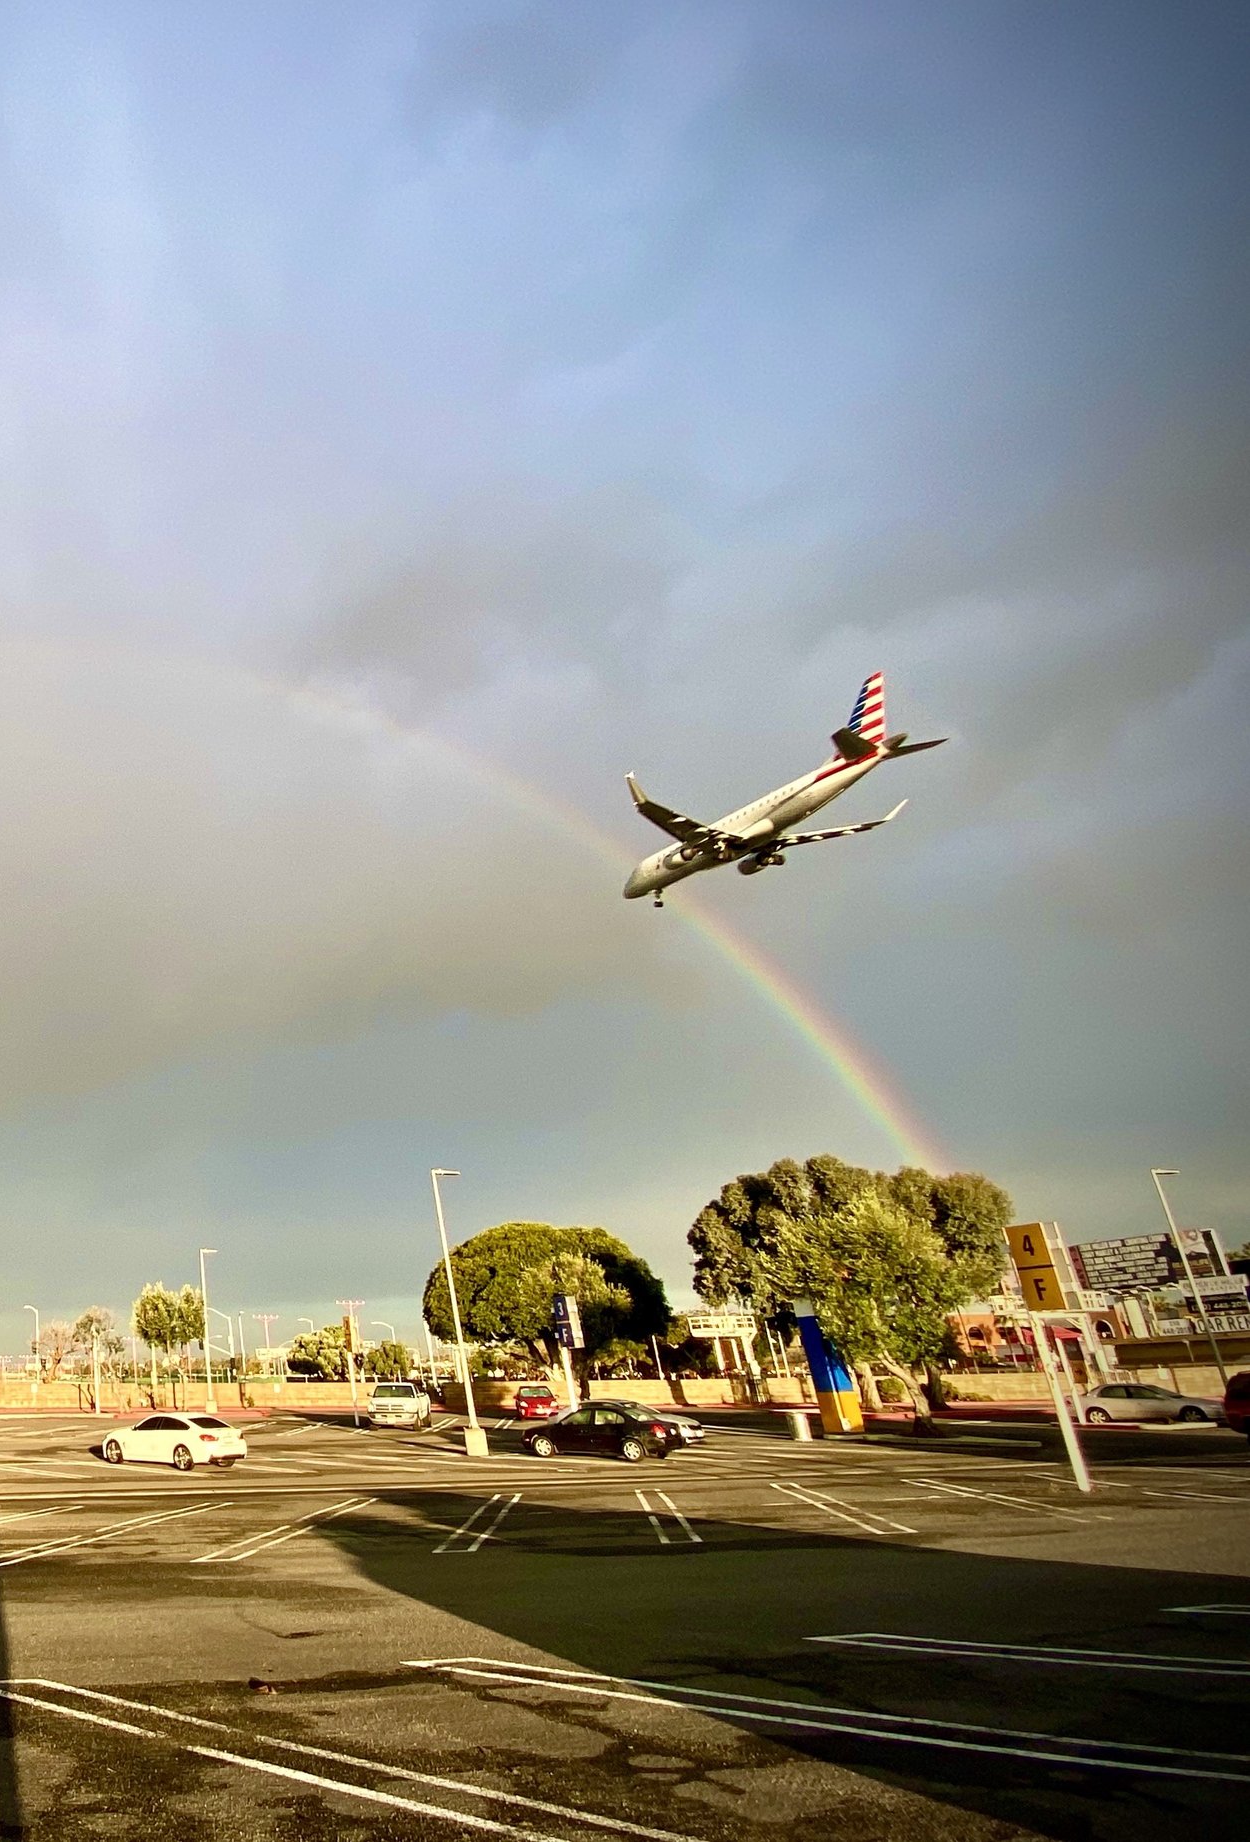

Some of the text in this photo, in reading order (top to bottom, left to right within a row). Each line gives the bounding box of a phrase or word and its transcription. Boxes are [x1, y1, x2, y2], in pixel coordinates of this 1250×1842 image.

[1023, 1234, 1035, 1256] 4
[1033, 1278, 1047, 1301] F
[557, 1302, 564, 1316] 3
[1197, 1317, 1225, 1332] CAR
[562, 1328, 568, 1342] F
